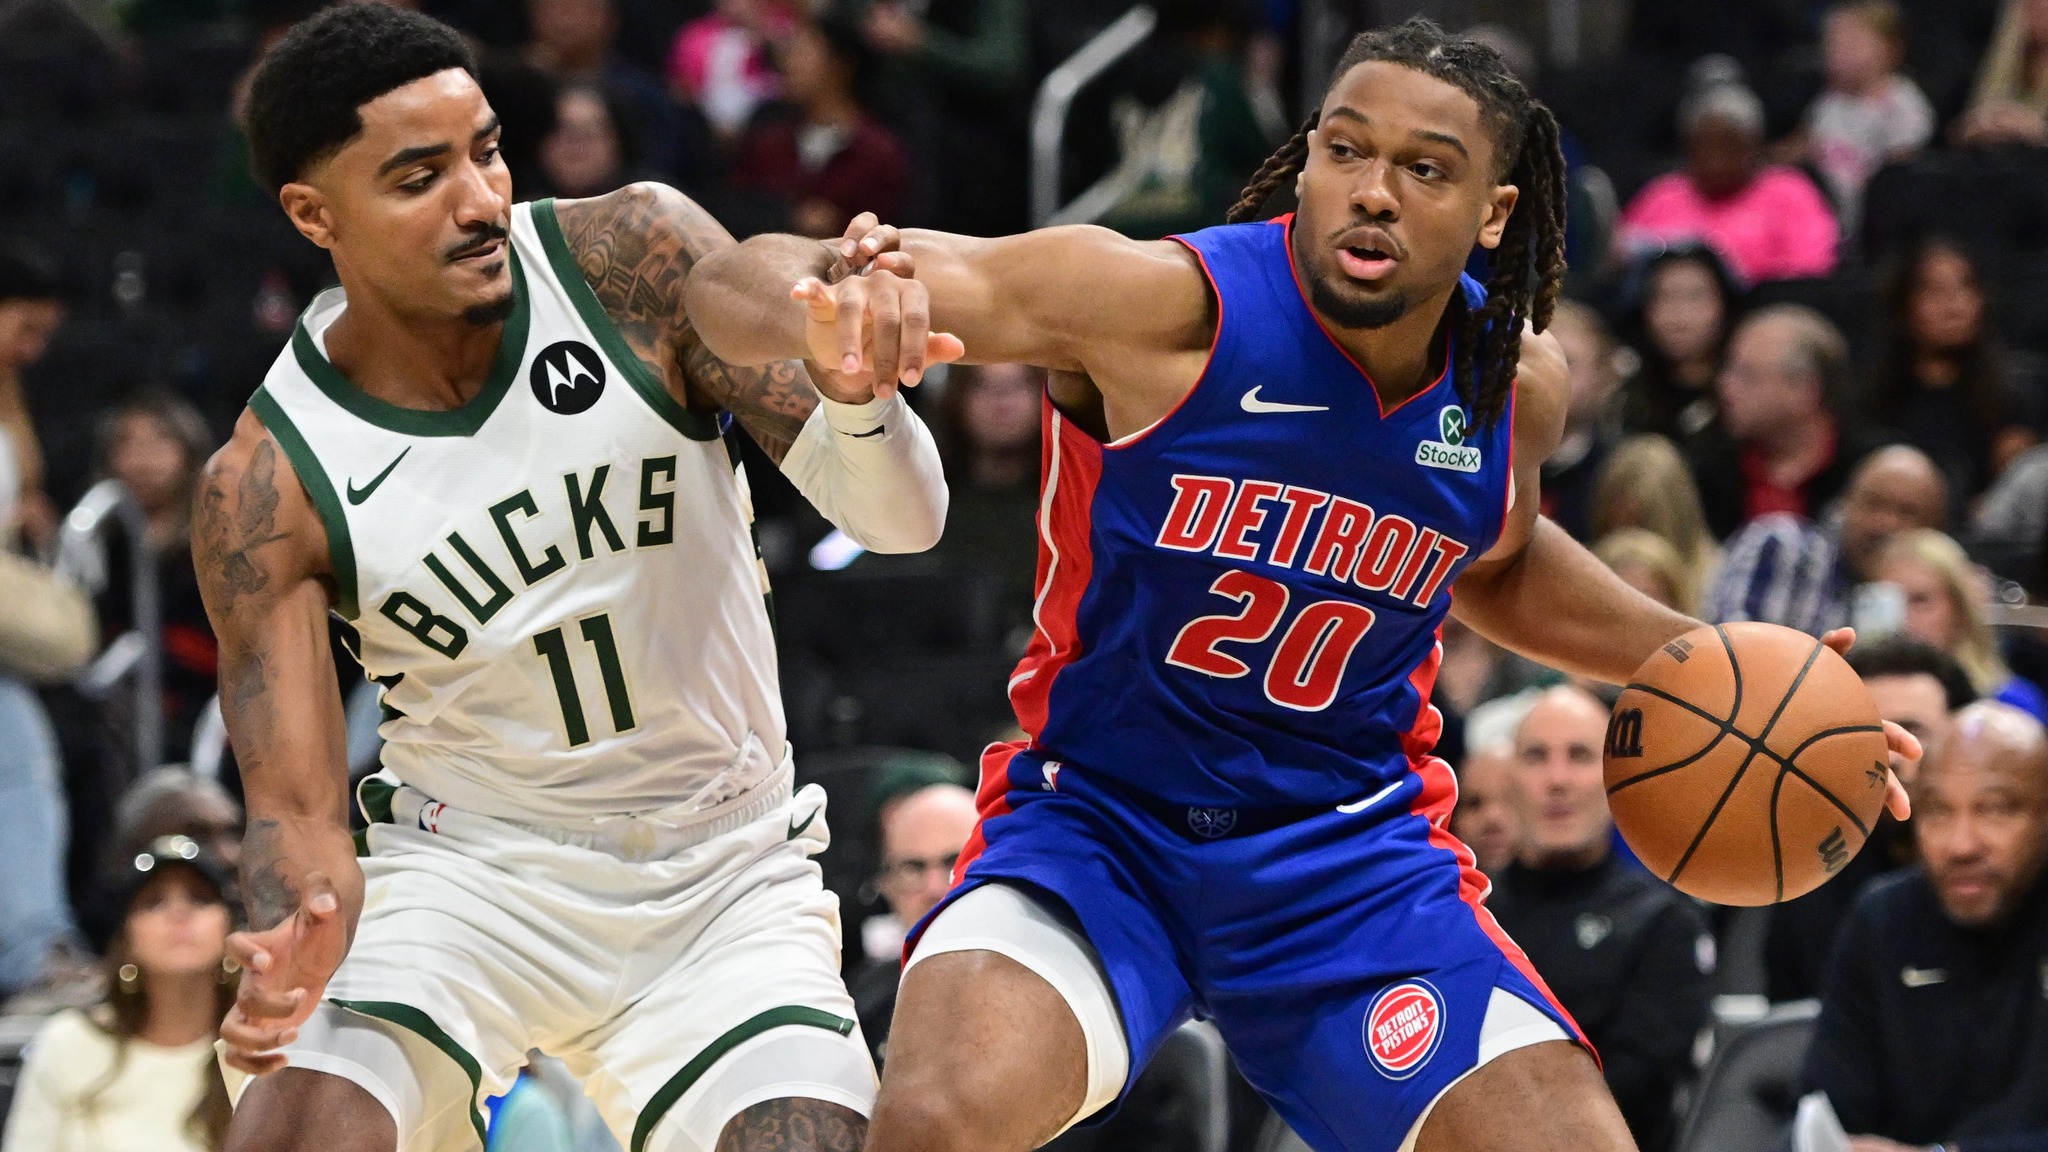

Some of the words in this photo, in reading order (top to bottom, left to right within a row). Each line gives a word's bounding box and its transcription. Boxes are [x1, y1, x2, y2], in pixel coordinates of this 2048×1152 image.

[1418, 444, 1479, 468] StockX
[377, 453, 678, 661] BUCKS
[1155, 473, 1469, 609] DETROIT
[532, 612, 637, 748] 11
[1165, 569, 1376, 712] 20
[1375, 999, 1424, 1041] DETROIT
[1380, 1012, 1429, 1056] PISTONS
